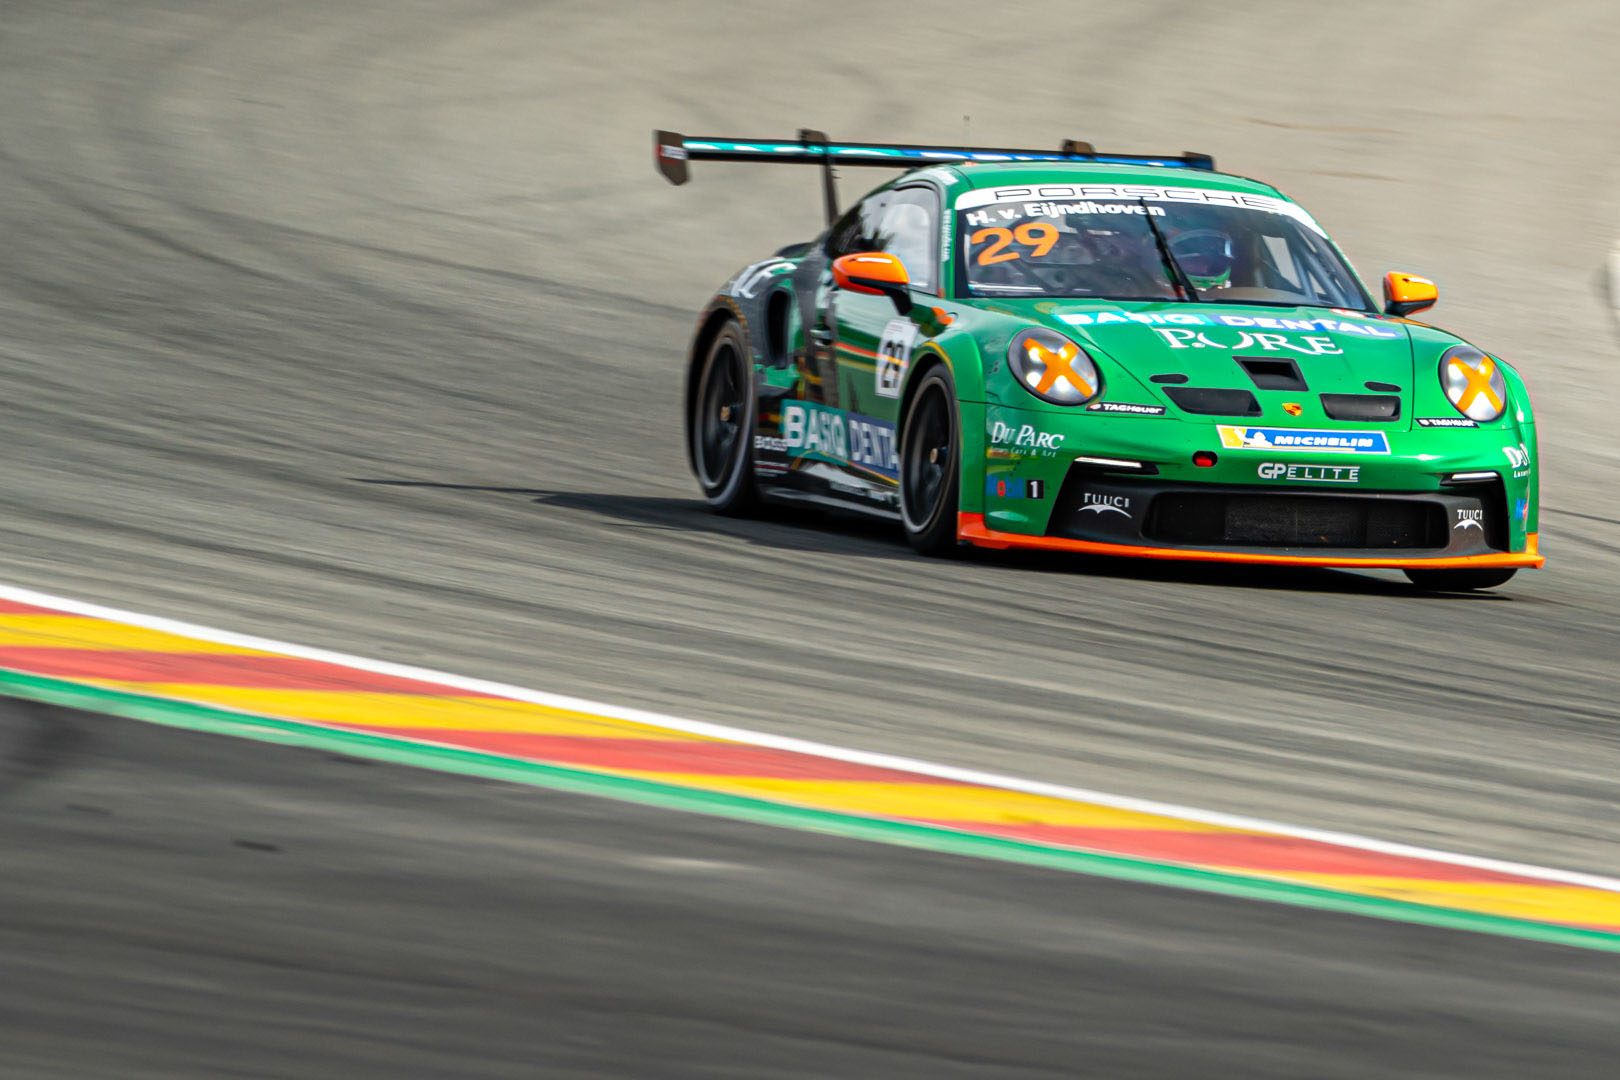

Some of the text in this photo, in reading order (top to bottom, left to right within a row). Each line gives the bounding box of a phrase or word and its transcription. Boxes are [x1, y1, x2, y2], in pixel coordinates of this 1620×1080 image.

[994, 187, 1278, 211] PORSCHE
[965, 207, 996, 227] H.
[1024, 201, 1166, 219] Eijndhoven
[970, 222, 1060, 266] 29
[1219, 315, 1396, 337] DENTAL
[1273, 434, 1374, 448] MICHELIN
